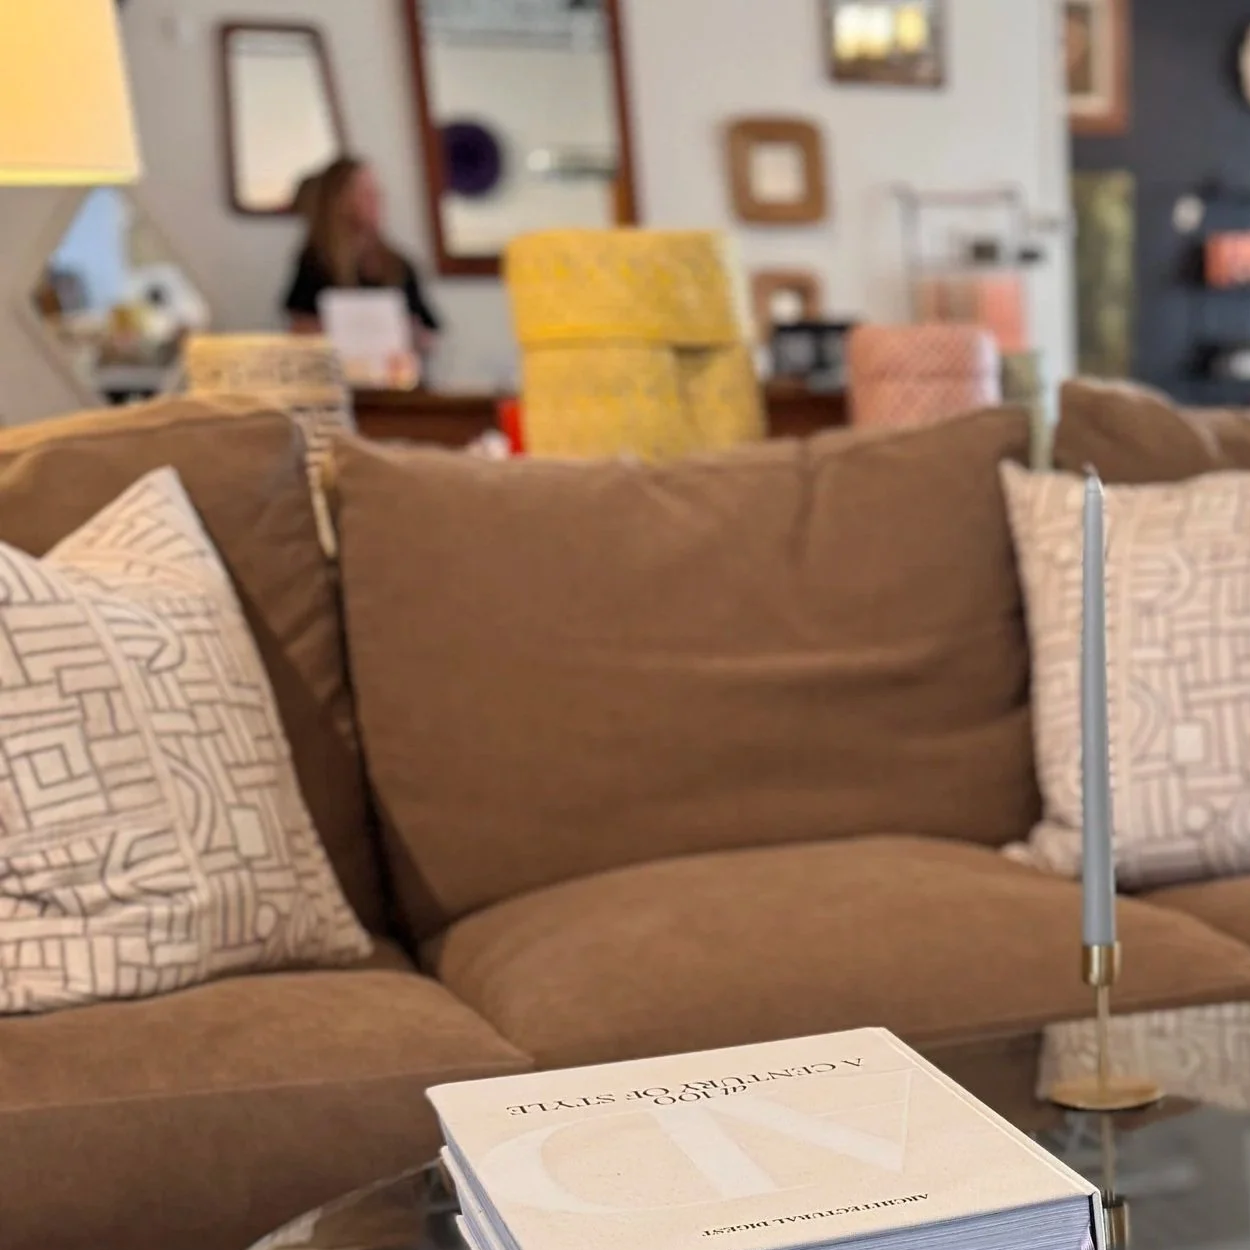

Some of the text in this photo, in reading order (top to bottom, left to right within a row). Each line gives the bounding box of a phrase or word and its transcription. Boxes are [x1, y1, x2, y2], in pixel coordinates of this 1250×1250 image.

[506, 1057, 864, 1116] A CENTURY OF STYLE
[653, 1085, 748, 1106] at 100
[701, 1193, 929, 1237] ARCHITECTURAL DIGEST
